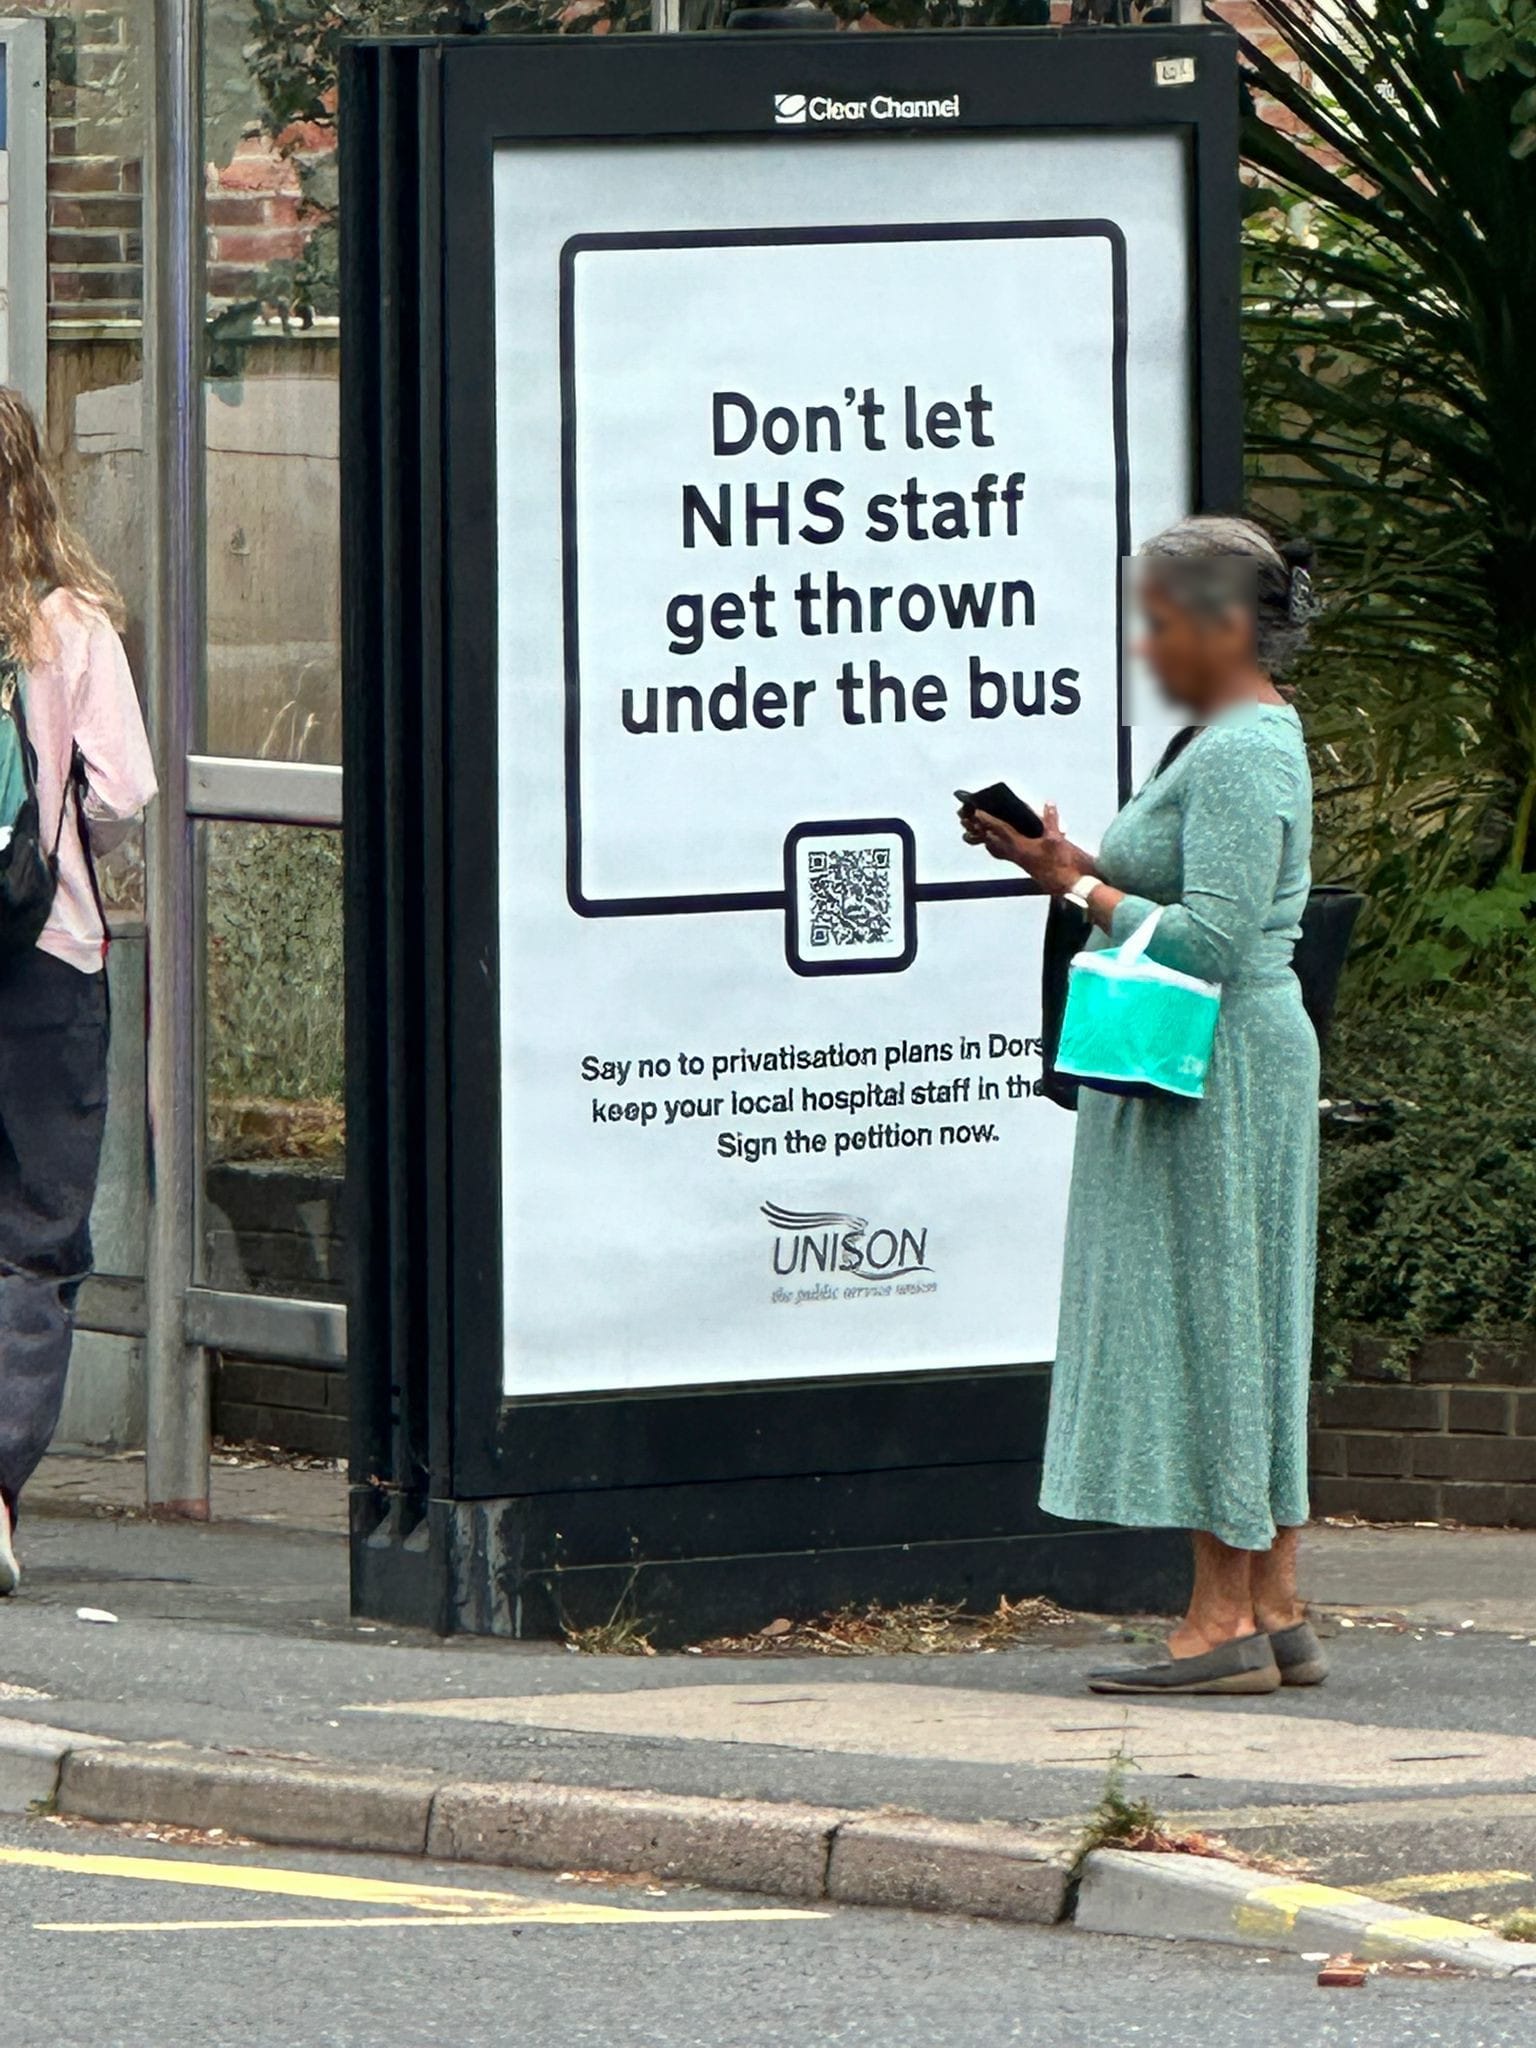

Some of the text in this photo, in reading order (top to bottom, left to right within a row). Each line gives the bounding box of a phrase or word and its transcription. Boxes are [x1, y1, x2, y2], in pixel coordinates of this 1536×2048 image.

[809, 95, 960, 121] Clear Channel
[713, 385, 994, 455] Don't let
[683, 473, 1025, 548] NHS staff
[667, 571, 1034, 655] get thrown
[622, 656, 1080, 734] under the bus
[581, 1034, 1043, 1086] Say no to privatisation plans in Dors
[592, 1098, 657, 1126] keep
[664, 1098, 724, 1125] your
[731, 1087, 794, 1115] local
[801, 1081, 904, 1114] hospital
[911, 1077, 971, 1105] staff
[978, 1075, 1000, 1101] in
[717, 1123, 1000, 1162] Sign the petition now.
[773, 1228, 928, 1276] UNISON
